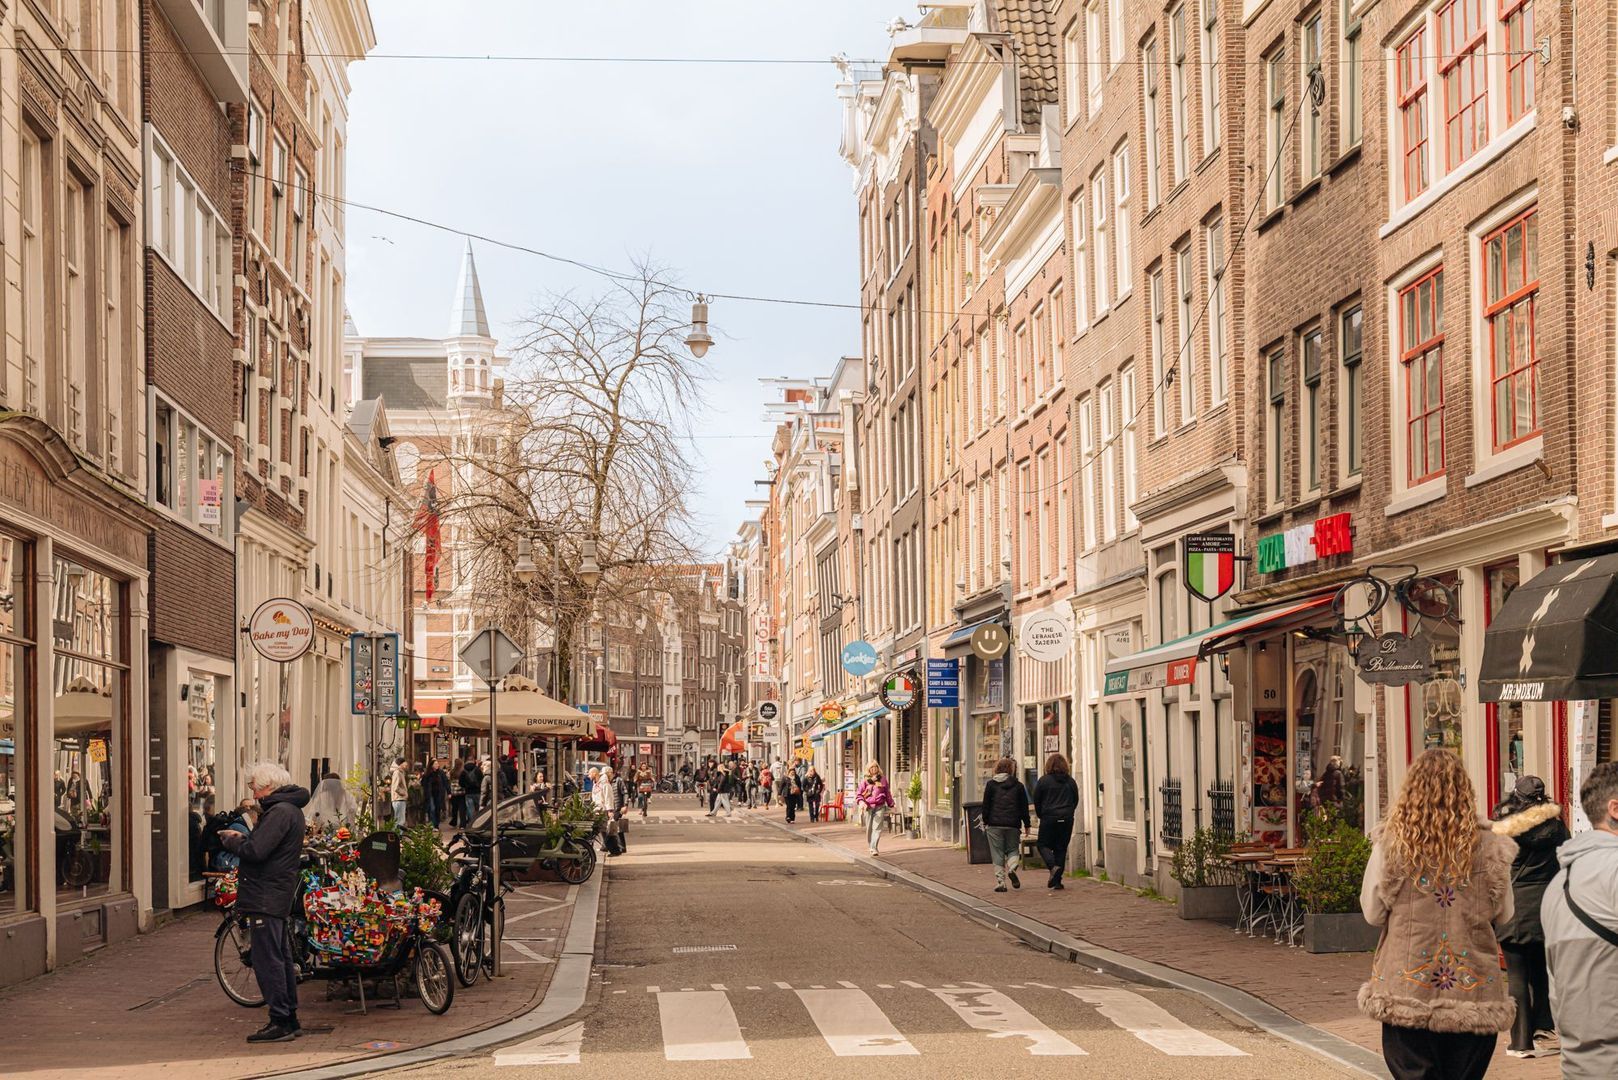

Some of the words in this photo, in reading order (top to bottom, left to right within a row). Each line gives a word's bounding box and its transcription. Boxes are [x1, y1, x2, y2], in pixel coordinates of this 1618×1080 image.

[252, 631, 275, 640] Bake
[276, 630, 290, 639] my
[292, 627, 310, 637] Day
[759, 616, 768, 674] HOTEL
[1380, 639, 1398, 654] De
[844, 652, 875, 664] Cookies
[1174, 664, 1189, 680] DINNER
[1264, 690, 1276, 699] 50
